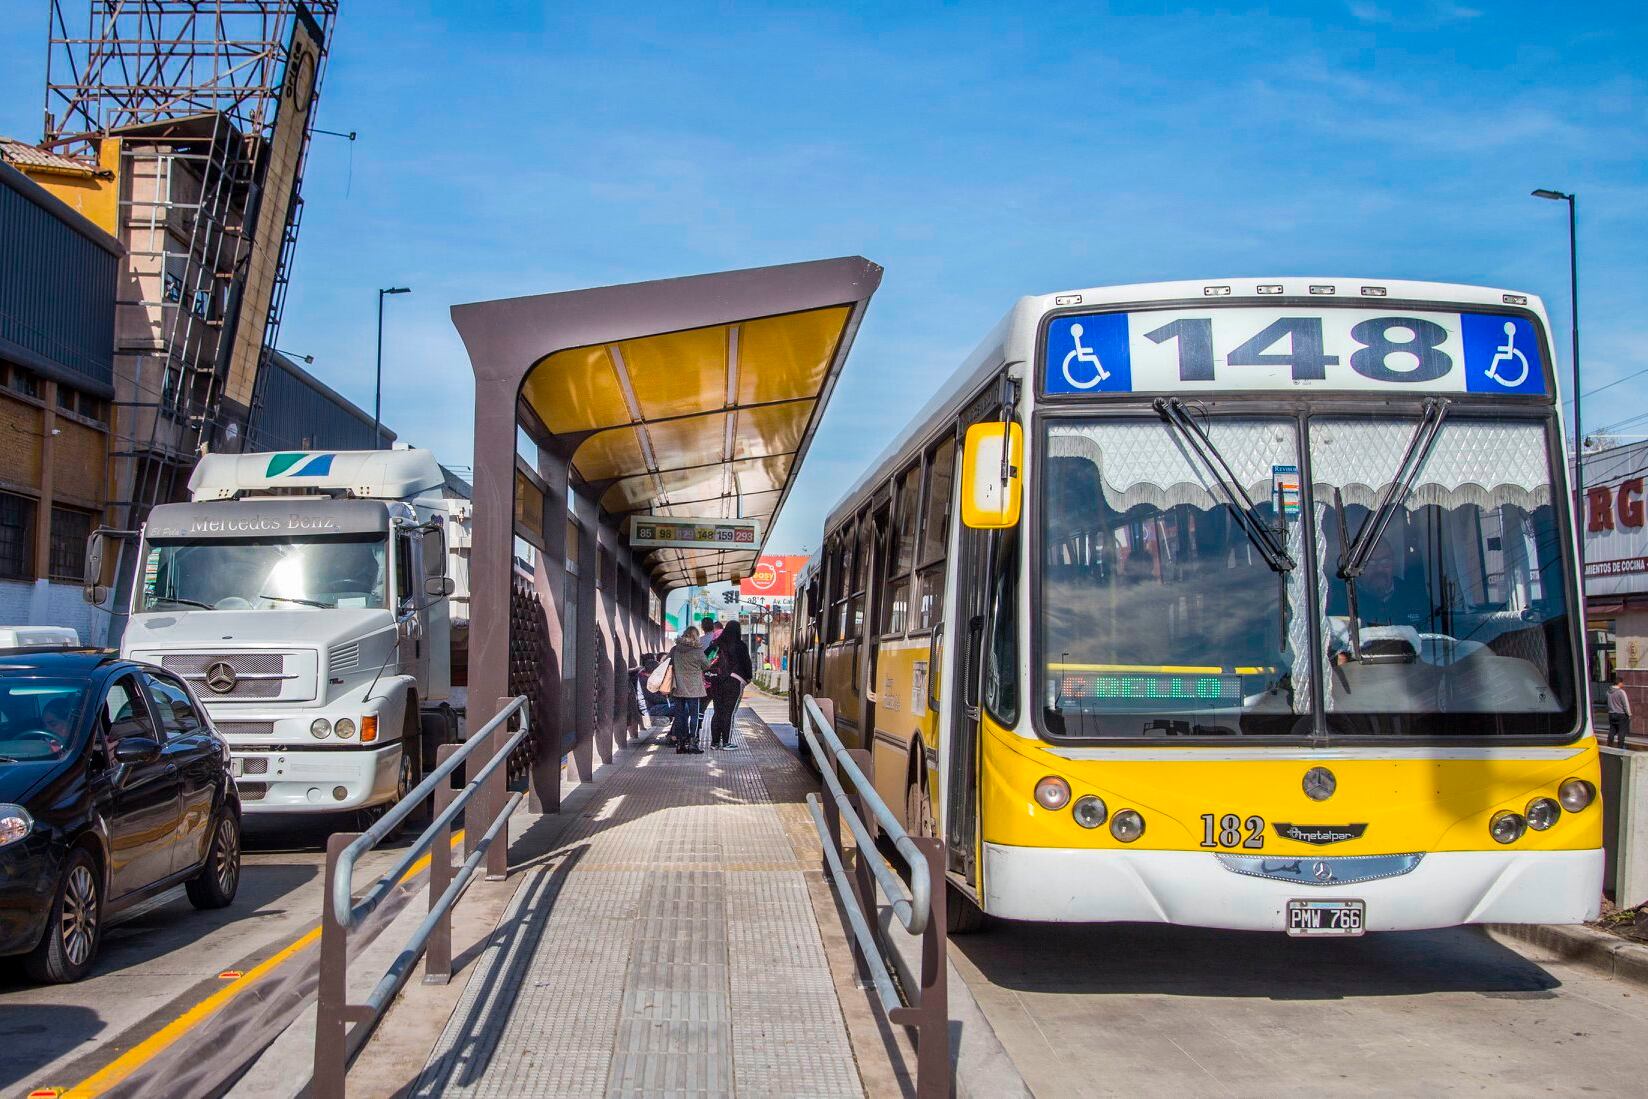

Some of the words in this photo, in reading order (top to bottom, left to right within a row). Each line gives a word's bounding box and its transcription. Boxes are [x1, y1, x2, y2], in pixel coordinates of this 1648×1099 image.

[1143, 317, 1454, 382] 148
[190, 514, 281, 533] Mercedes
[287, 513, 334, 529] Benz
[639, 528, 652, 539] 85
[659, 529, 672, 539] 98
[698, 530, 714, 540] 148
[718, 531, 734, 541] 159
[736, 531, 753, 541] 293
[1612, 563, 1621, 573] DE
[1621, 559, 1645, 572] COCINA
[1095, 677, 1222, 699] BELLO
[1200, 813, 1265, 849] 182
[1291, 909, 1321, 928] PMW
[1330, 909, 1360, 928] 766
